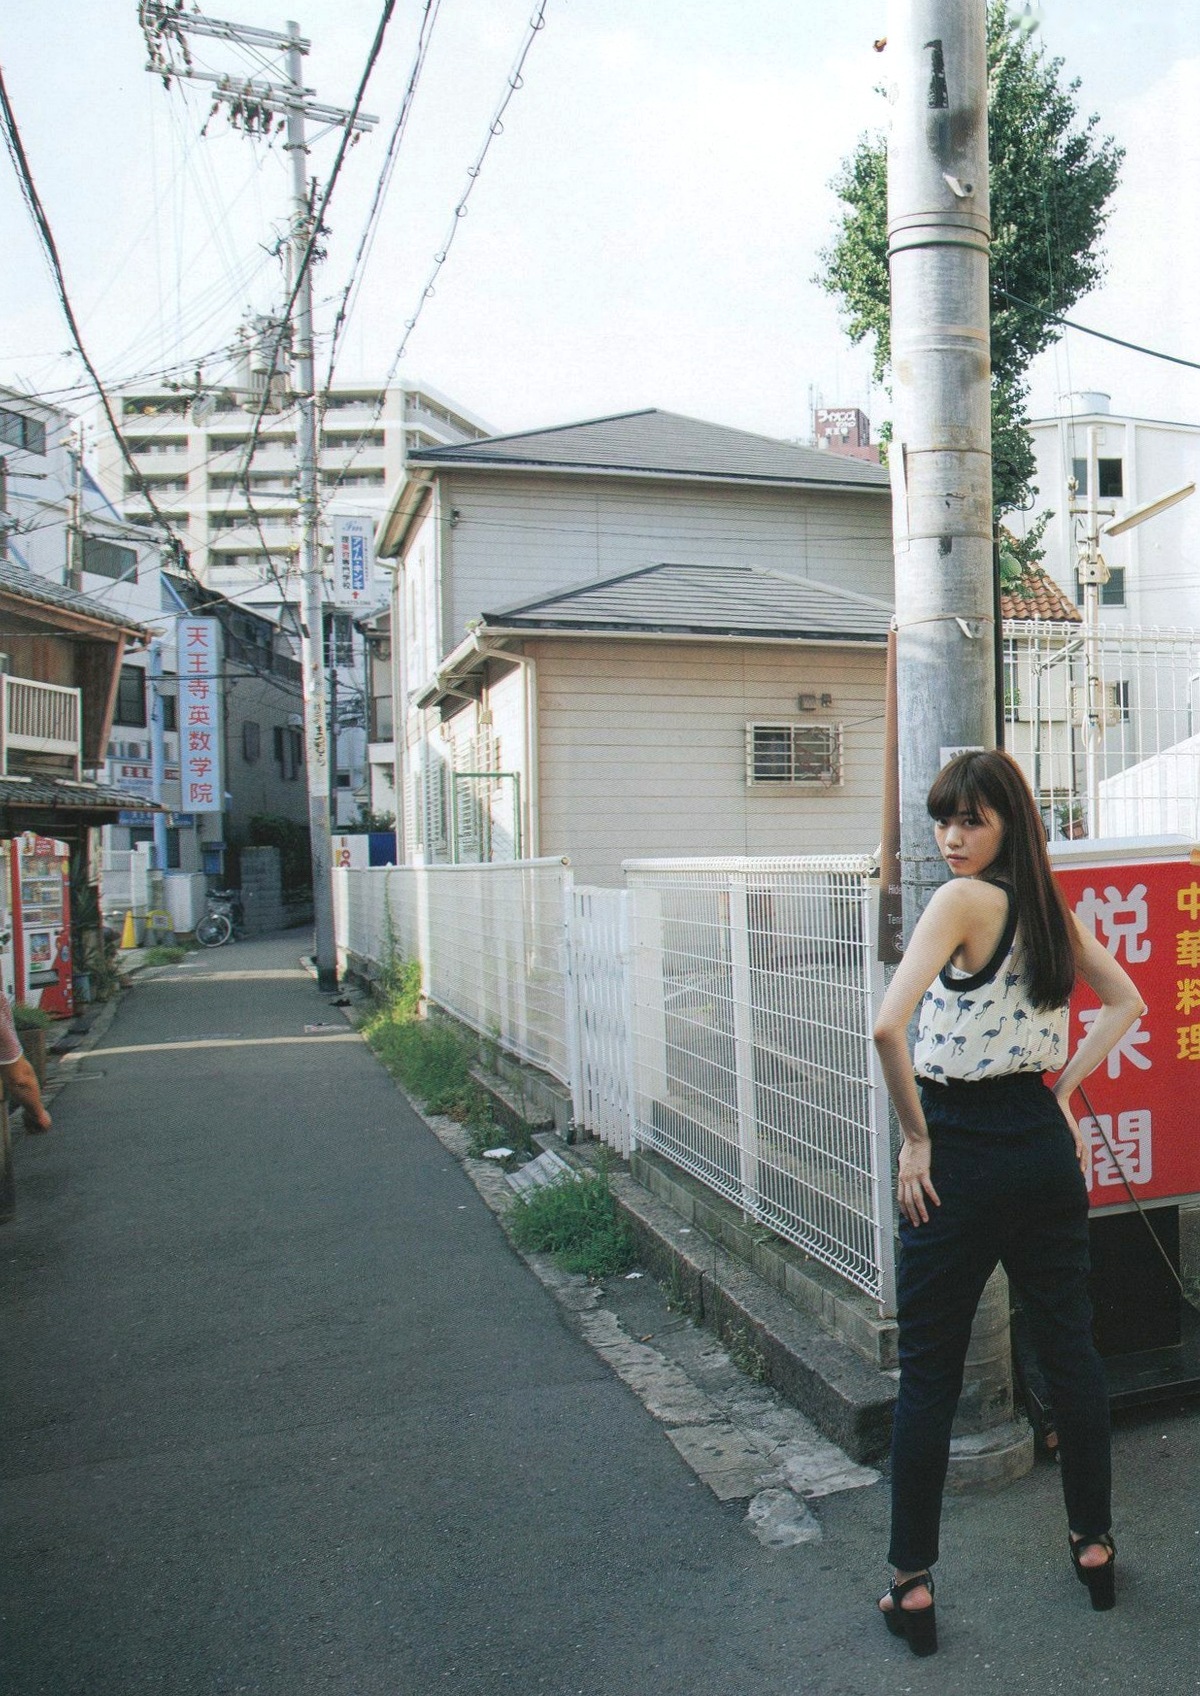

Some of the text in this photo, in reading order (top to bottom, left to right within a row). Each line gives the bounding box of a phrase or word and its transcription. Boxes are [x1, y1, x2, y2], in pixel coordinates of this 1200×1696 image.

[186, 626, 214, 803] 天王寺英数学院
